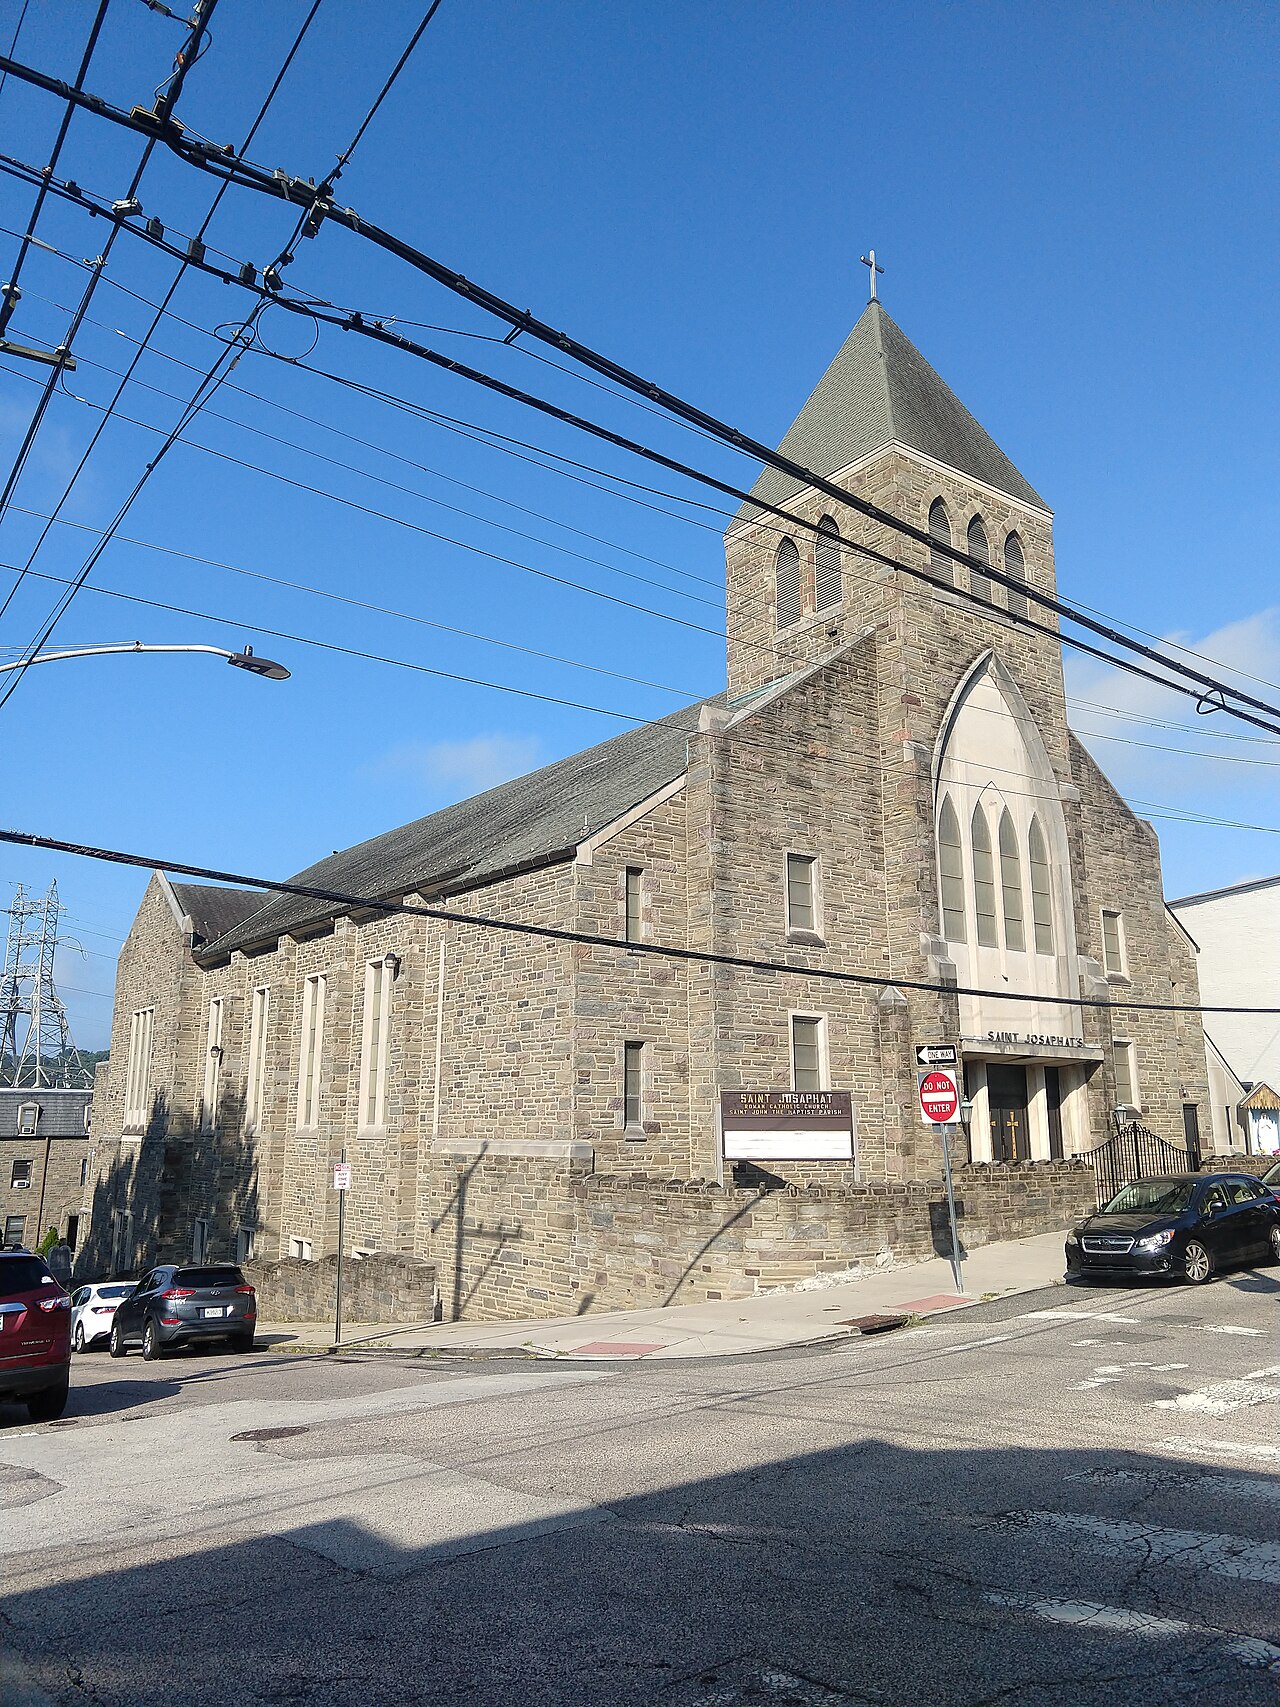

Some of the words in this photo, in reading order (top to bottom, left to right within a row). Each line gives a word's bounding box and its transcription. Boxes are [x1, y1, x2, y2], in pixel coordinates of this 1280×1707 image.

[987, 1031, 1019, 1043] SAINT
[927, 1051, 939, 1059] ONE
[940, 1050, 952, 1058] WAY
[923, 1082, 933, 1091] DO
[936, 1081, 950, 1090] NOT
[740, 1093, 771, 1103] SAINT
[928, 1103, 951, 1113] ENTER
